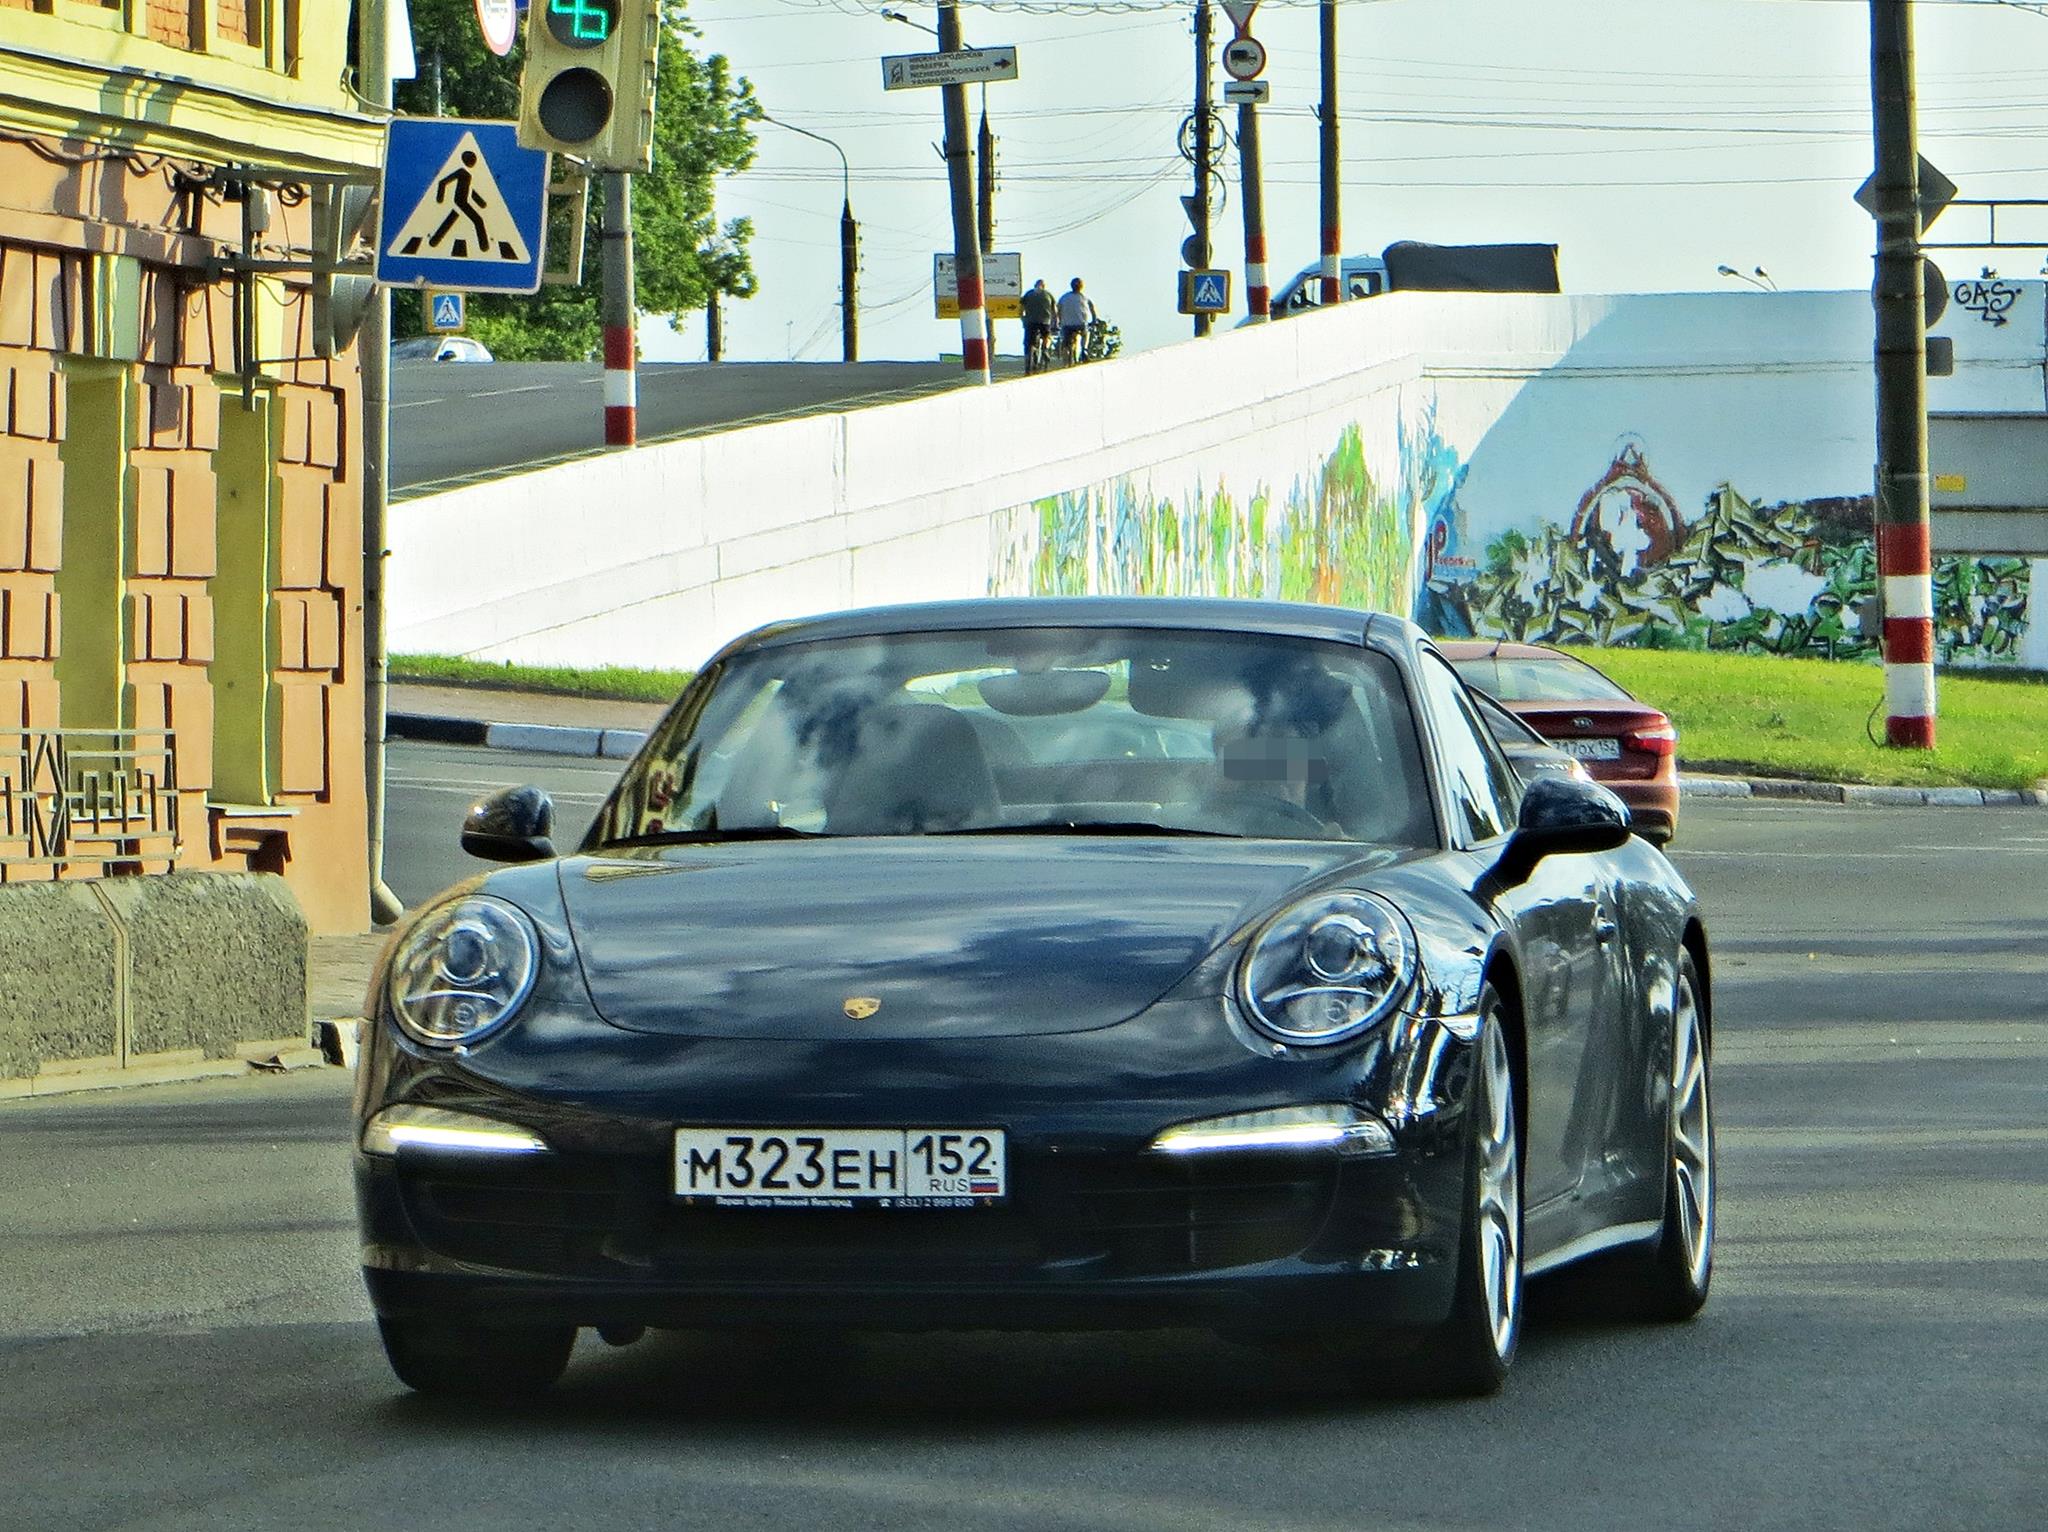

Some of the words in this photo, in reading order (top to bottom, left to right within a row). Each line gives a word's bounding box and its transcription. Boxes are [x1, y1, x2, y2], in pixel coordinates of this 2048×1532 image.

[1954, 281, 2017, 313] GAS
[690, 1136, 897, 1190] М323ЕН
[913, 1135, 992, 1176] 152
[929, 1179, 969, 1192] RUS
